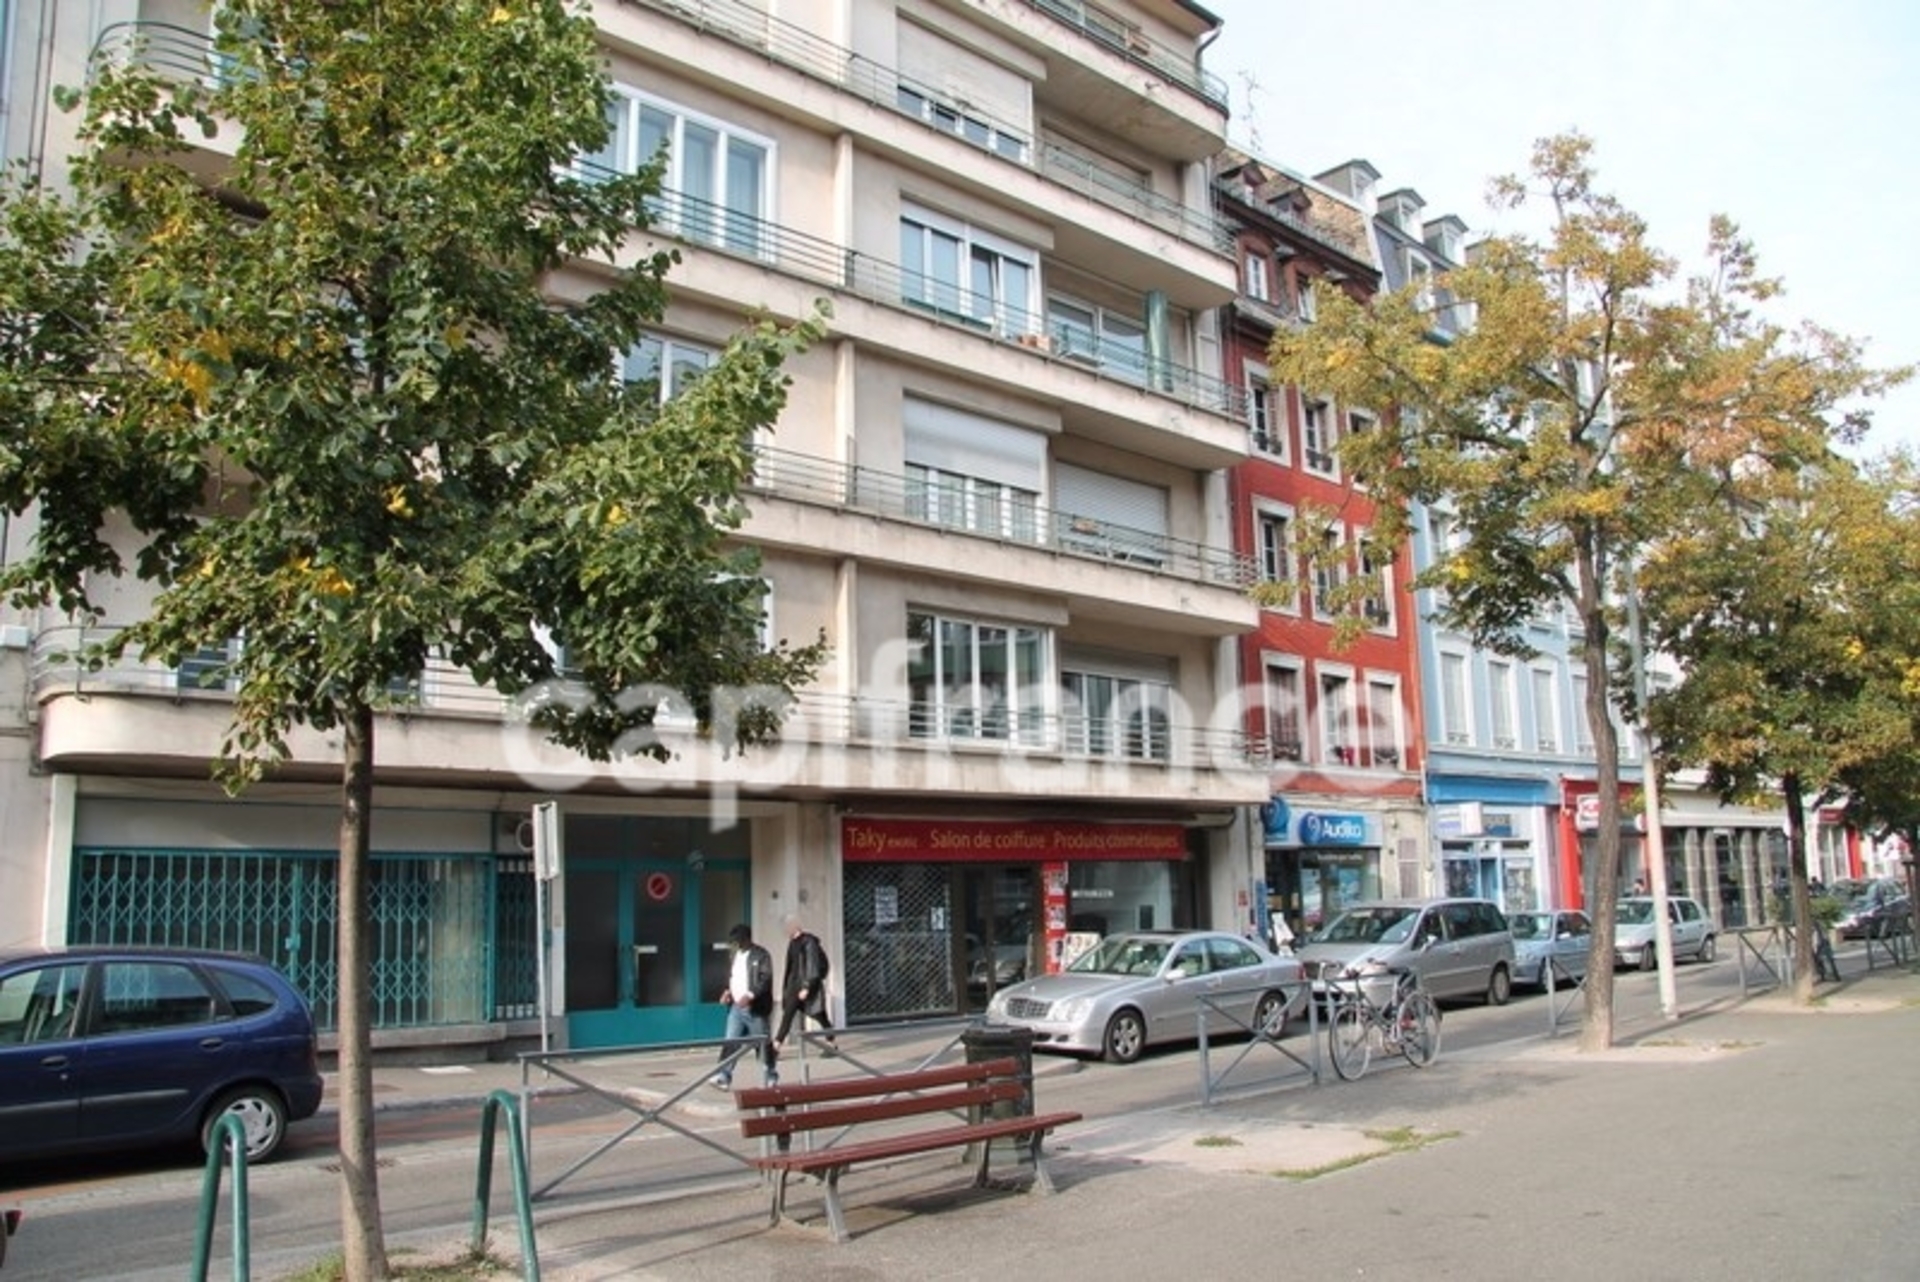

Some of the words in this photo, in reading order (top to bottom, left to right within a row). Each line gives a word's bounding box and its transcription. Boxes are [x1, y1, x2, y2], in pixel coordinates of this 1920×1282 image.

[847, 827, 887, 852] Taky
[930, 828, 970, 848] Salon
[974, 829, 992, 848] de
[995, 829, 1045, 848] coiffure
[1053, 830, 1104, 849] Produits
